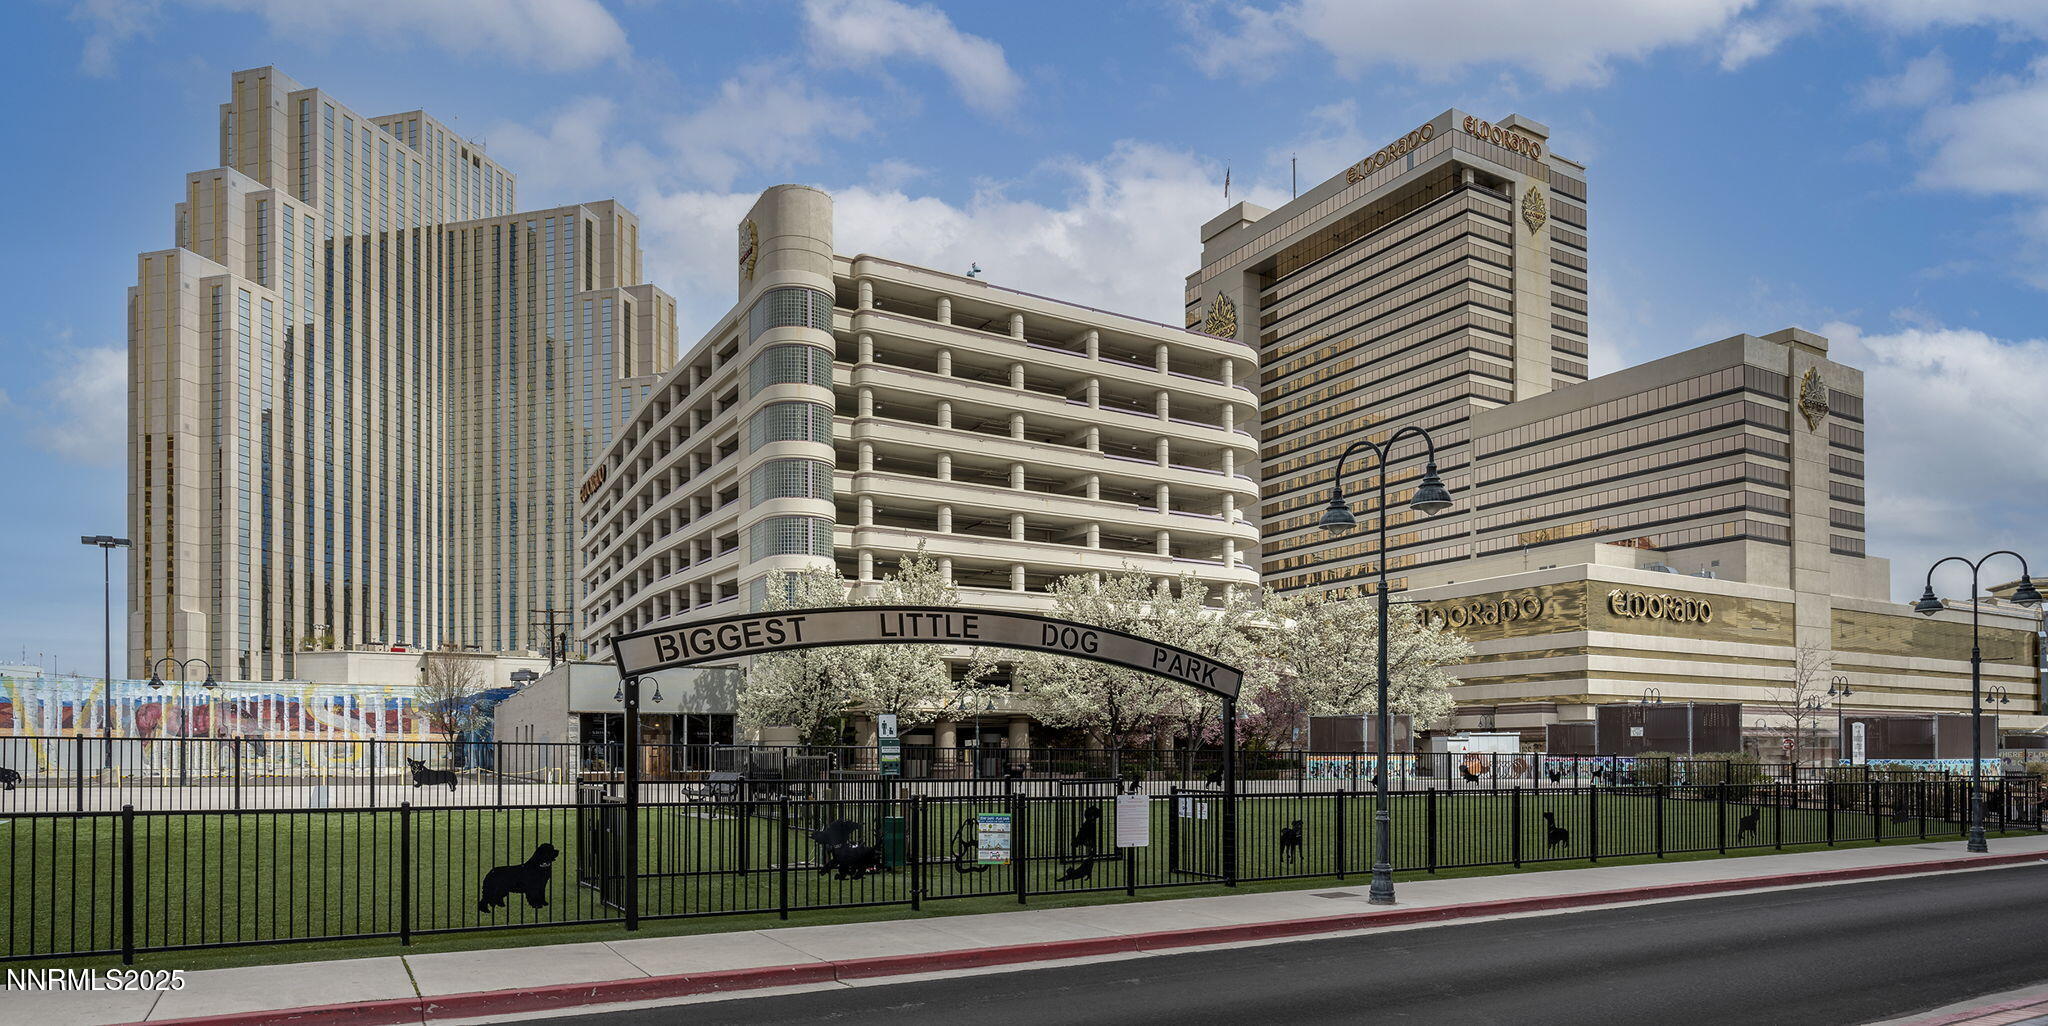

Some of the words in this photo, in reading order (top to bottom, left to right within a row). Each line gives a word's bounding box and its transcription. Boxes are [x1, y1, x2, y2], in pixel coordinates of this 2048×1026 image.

[1414, 593, 1544, 632] LDORADO
[652, 616, 806, 663] BIGGEST
[880, 612, 980, 639] LITTLE
[1041, 623, 1099, 653] DOG
[1152, 647, 1219, 688] PARK
